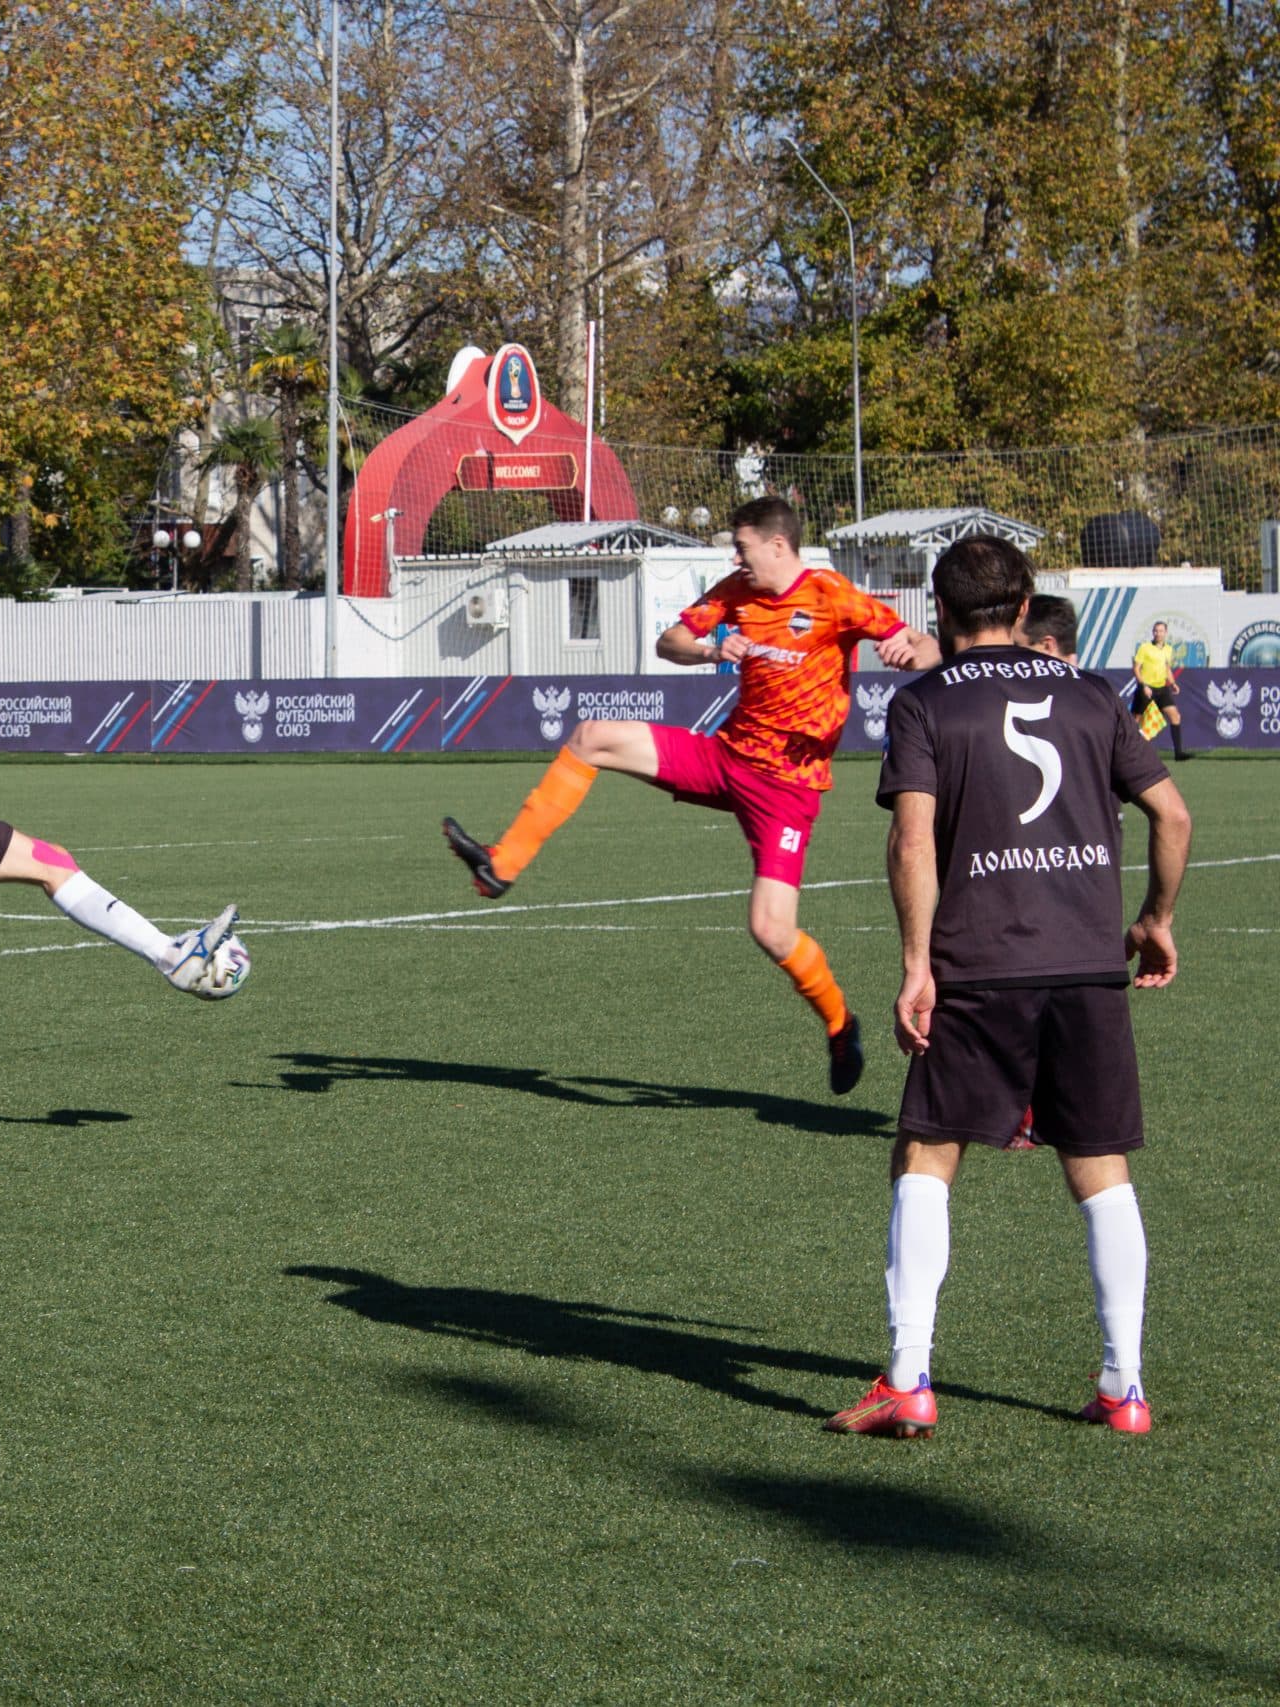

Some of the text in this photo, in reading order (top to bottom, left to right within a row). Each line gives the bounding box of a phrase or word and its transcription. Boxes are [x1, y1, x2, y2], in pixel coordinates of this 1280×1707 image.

[494, 465, 541, 478] WELCOME!
[940, 659, 1082, 686] ПЕРЕСВЕТ
[0, 695, 72, 711] РОССИЙСКИЙ
[276, 693, 355, 709] РОССИЙСКИЙ
[577, 690, 664, 706] РОССИЙСКИЙ
[0, 710, 72, 723] ФУТБОЛЬНЫЙ
[276, 708, 355, 723] ФУТБОЛЬНЫЙ
[577, 705, 664, 721] ФУТБОЛЬНЫЙ
[0, 724, 31, 737] СОЮЗ
[276, 723, 310, 737] СОЮЗ
[1003, 694, 1063, 825] 5
[779, 826, 802, 853] 21
[969, 844, 1111, 878] ДОМОДЕДОВ
